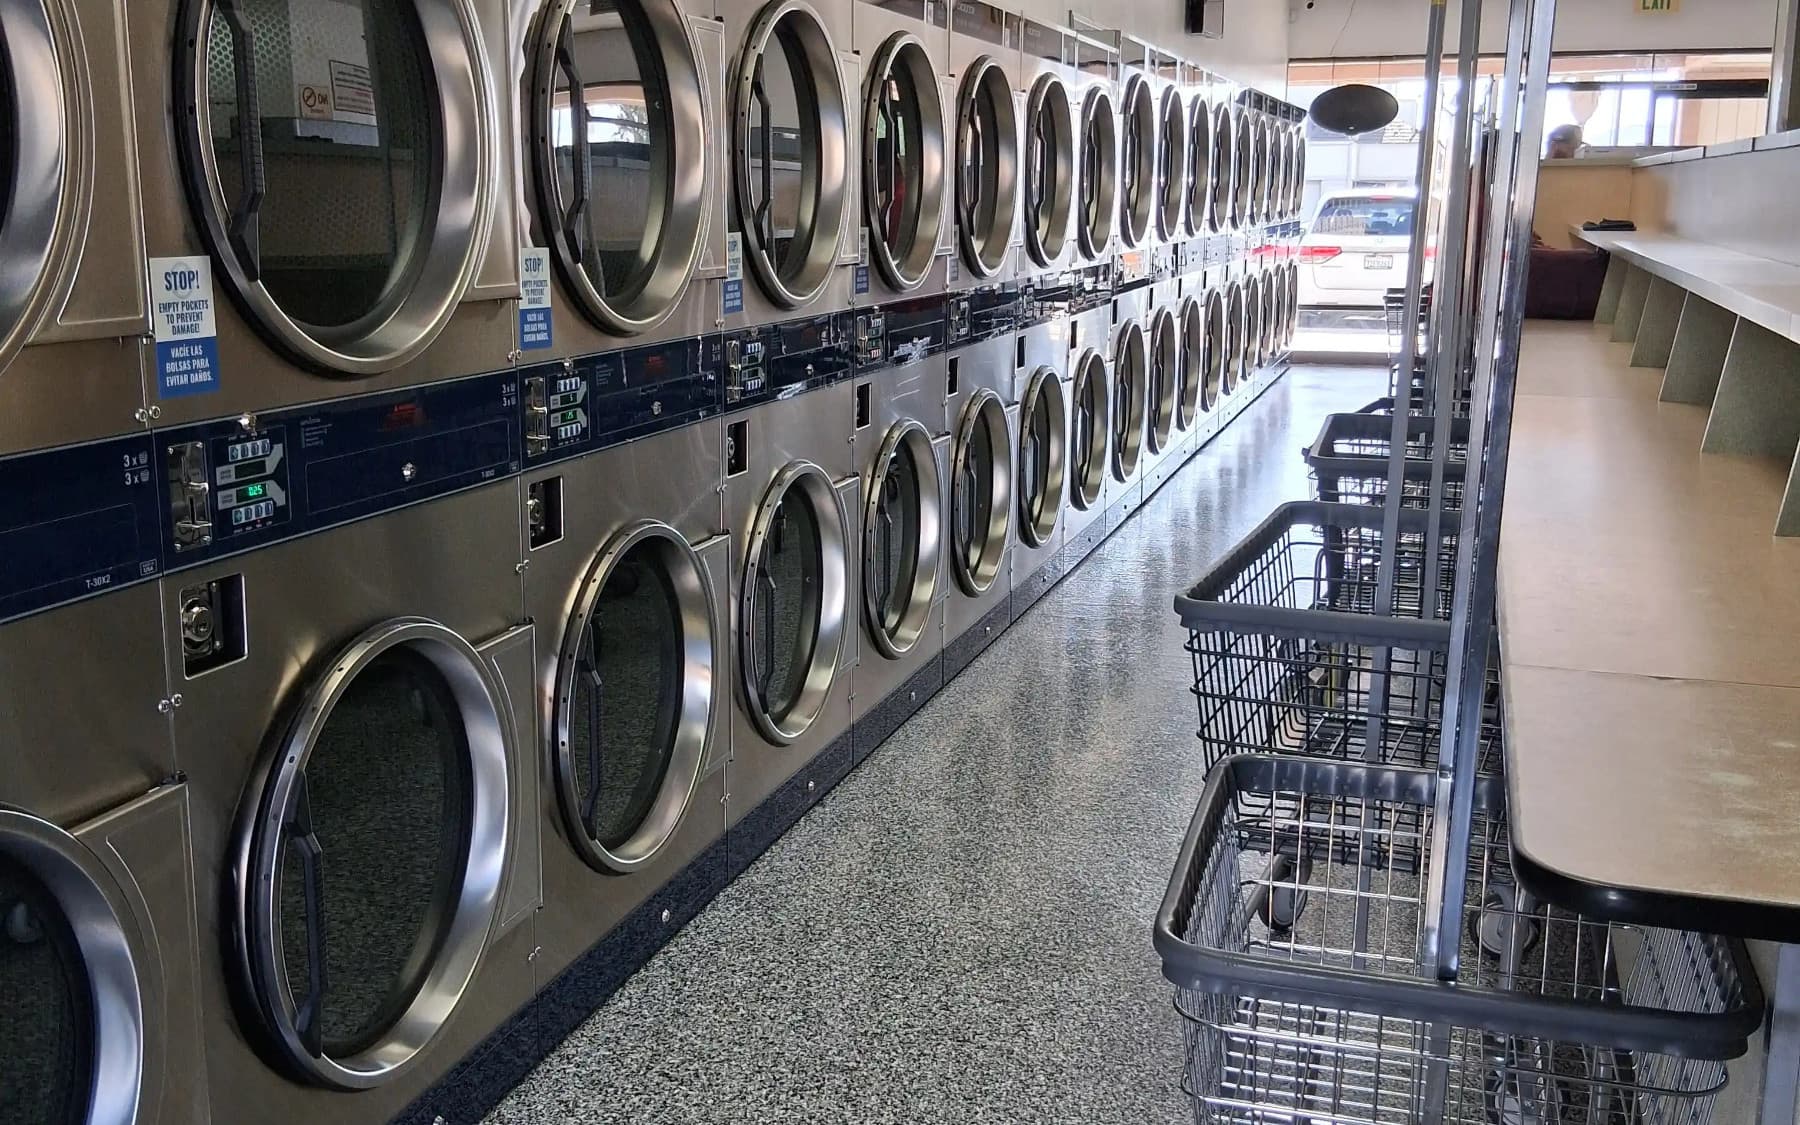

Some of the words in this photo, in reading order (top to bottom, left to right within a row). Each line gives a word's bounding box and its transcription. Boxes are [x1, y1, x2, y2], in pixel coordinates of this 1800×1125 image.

[525, 257, 543, 273] STOP!
[164, 270, 200, 291] STOP!
[158, 301, 180, 314] EMPTY
[181, 299, 209, 312] POCKETS
[166, 313, 175, 325] TO
[176, 311, 203, 324] PREVENT
[172, 323, 200, 336] DAMAGE!
[170, 343, 190, 359] VACÍE
[190, 345, 203, 357] LAS
[166, 361, 191, 374] BOLSAS
[192, 358, 210, 370] PARA
[166, 374, 190, 387] EVITAR
[123, 454, 130, 468] 3
[125, 472, 132, 486] 3
